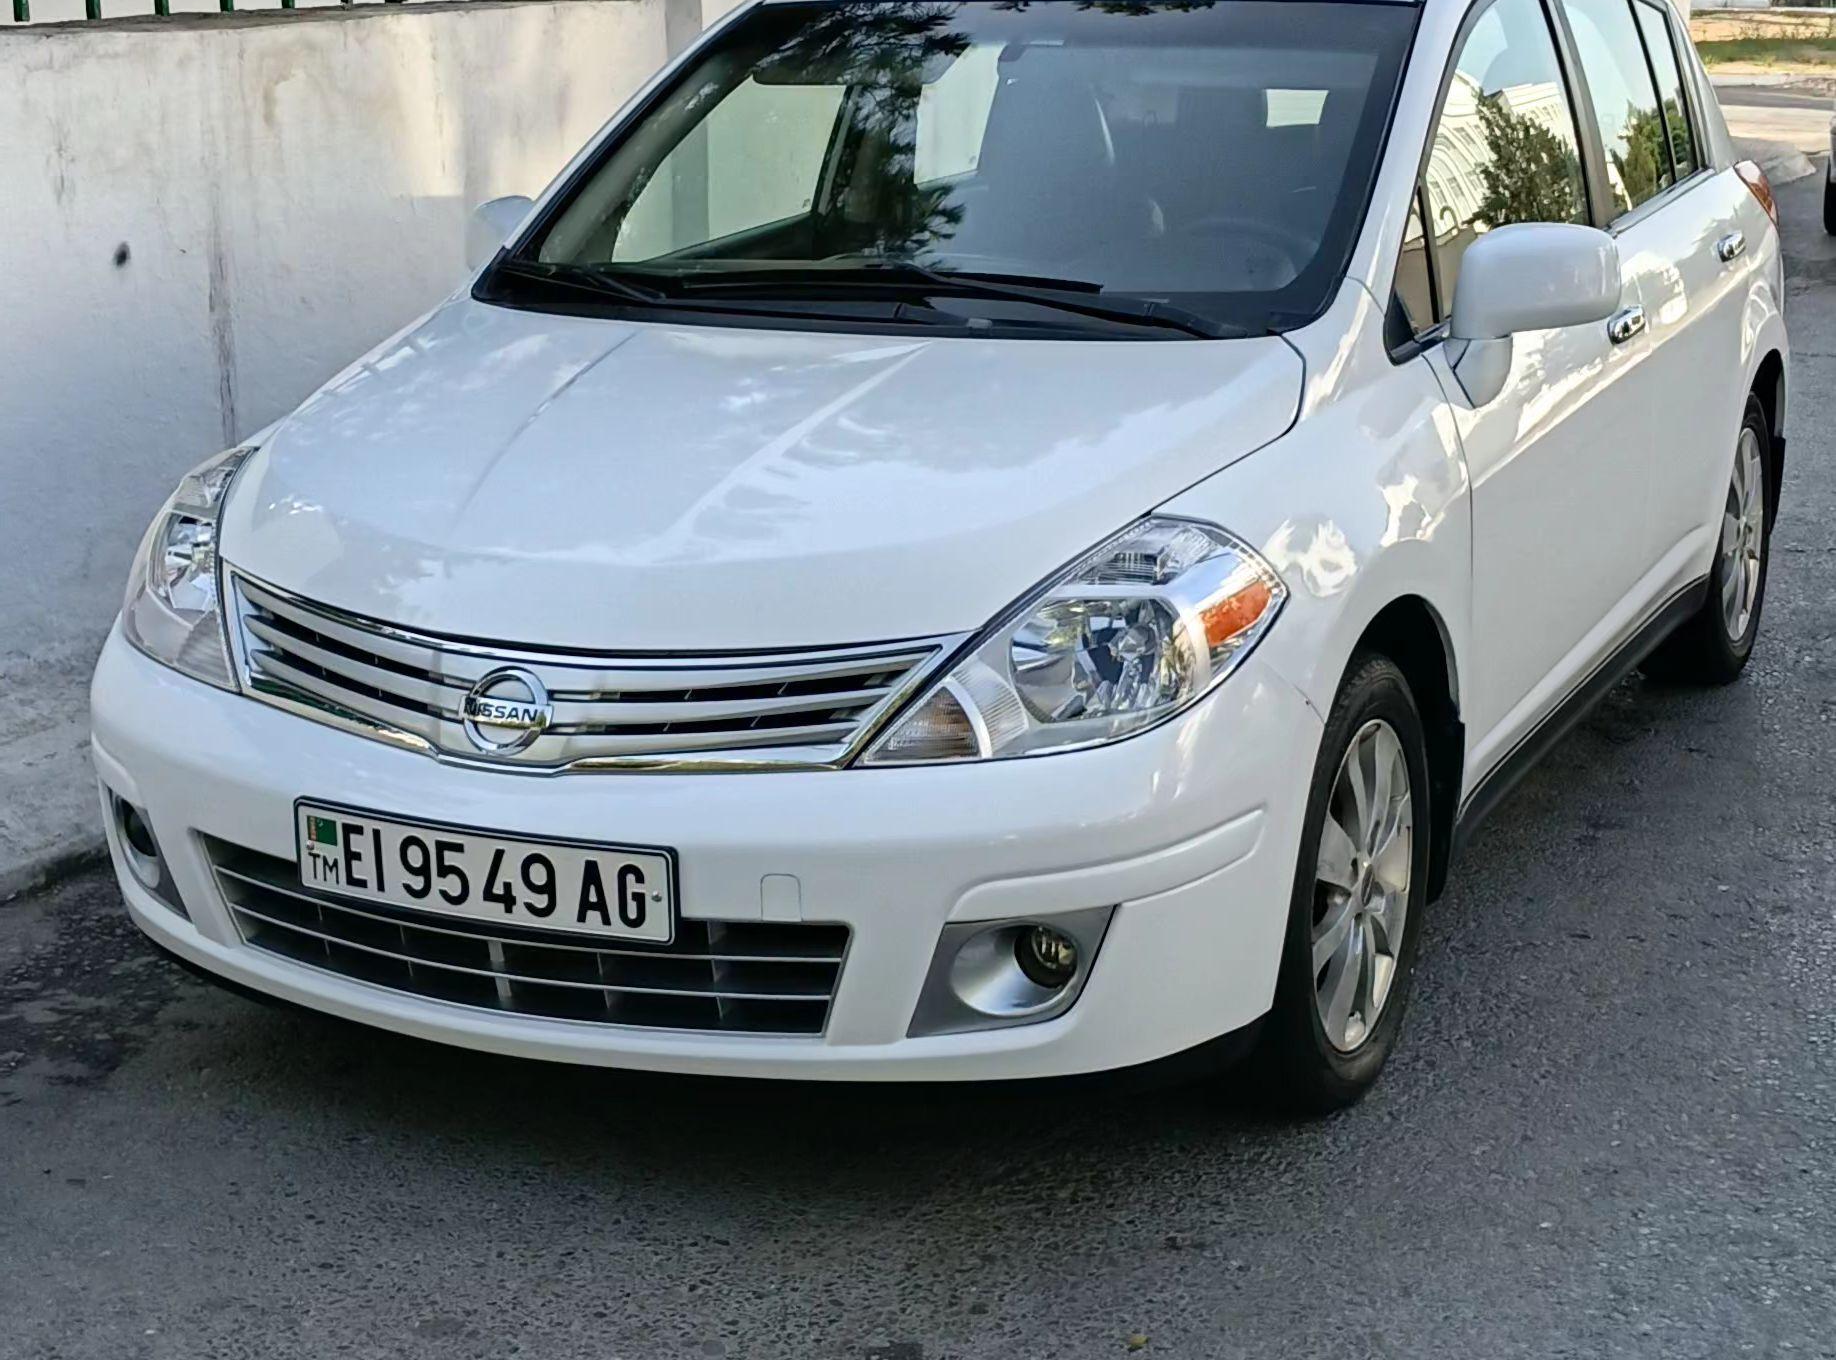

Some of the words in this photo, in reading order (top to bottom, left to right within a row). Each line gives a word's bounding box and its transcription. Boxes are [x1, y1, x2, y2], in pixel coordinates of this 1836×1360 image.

[464, 696, 538, 722] NISSAN
[307, 851, 340, 886] TM
[576, 859, 647, 929] AG
